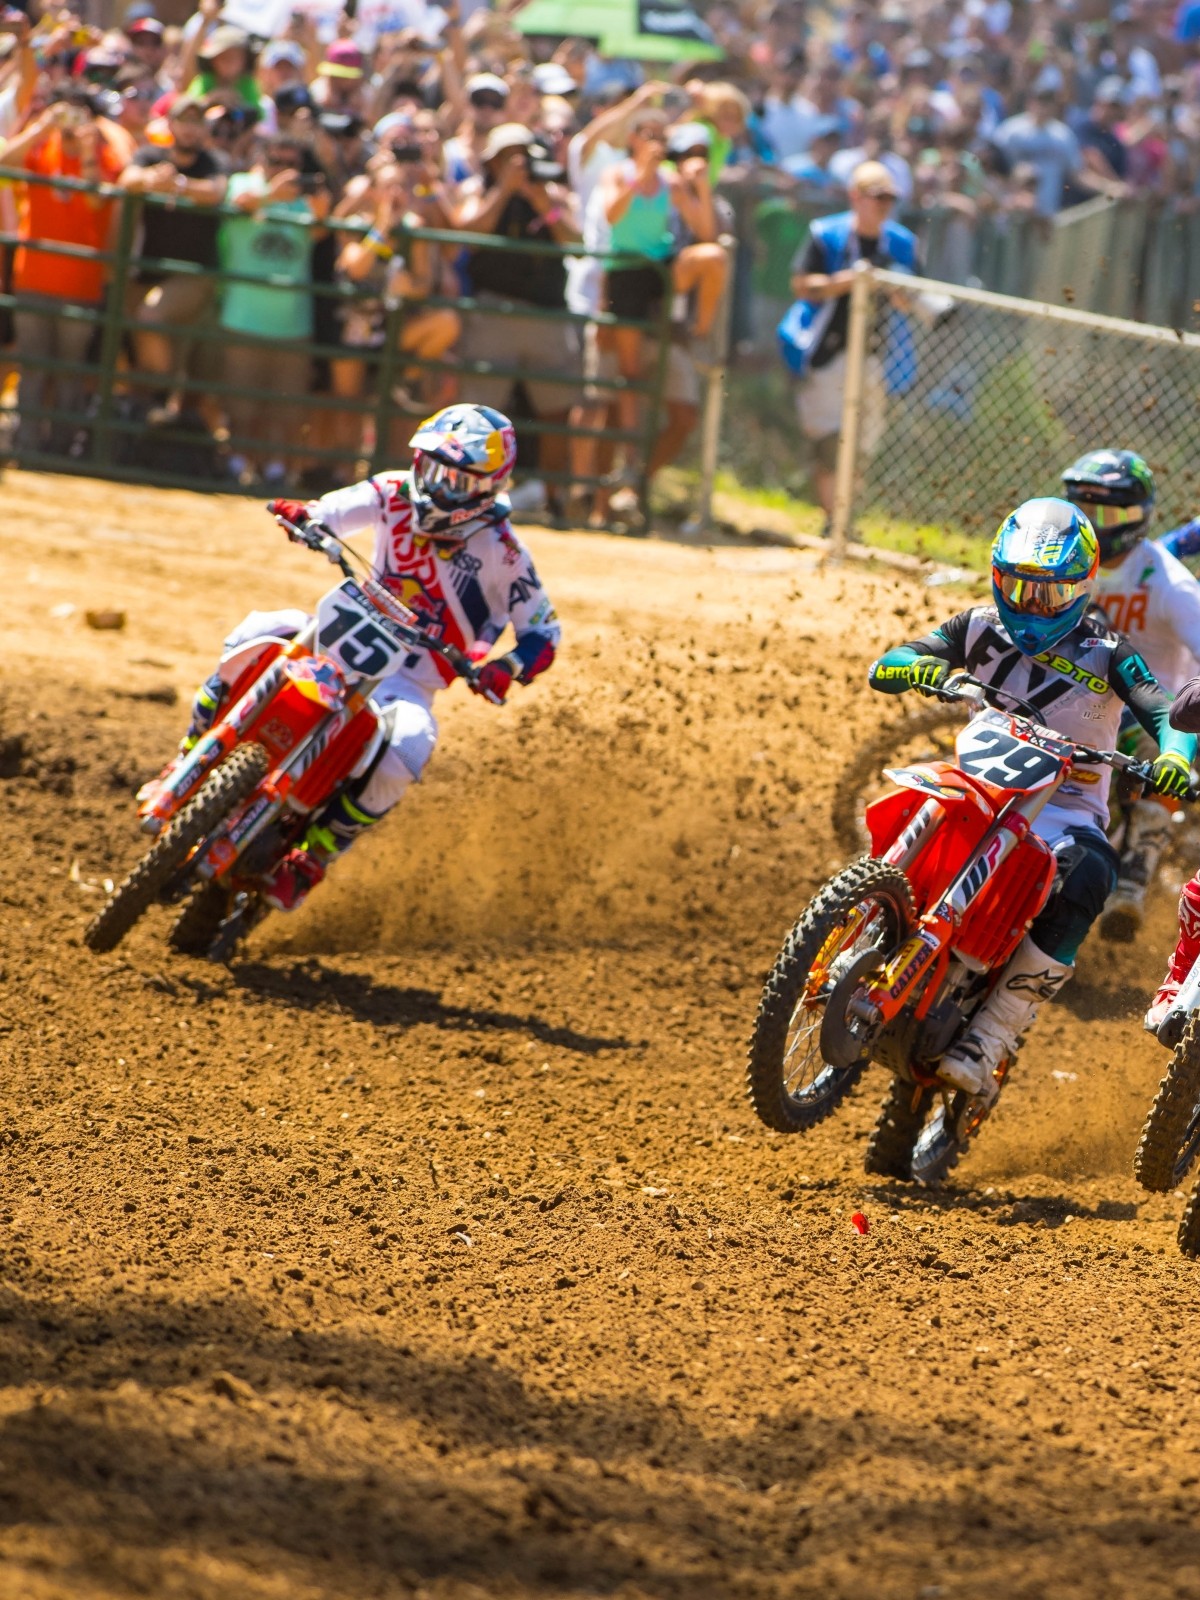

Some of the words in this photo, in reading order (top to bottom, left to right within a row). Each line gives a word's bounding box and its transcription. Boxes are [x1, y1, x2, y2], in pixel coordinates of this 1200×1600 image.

[319, 604, 400, 676] 15
[966, 625, 1075, 714] FLY
[958, 730, 1065, 790] 29
[891, 943, 933, 999] GALFER
